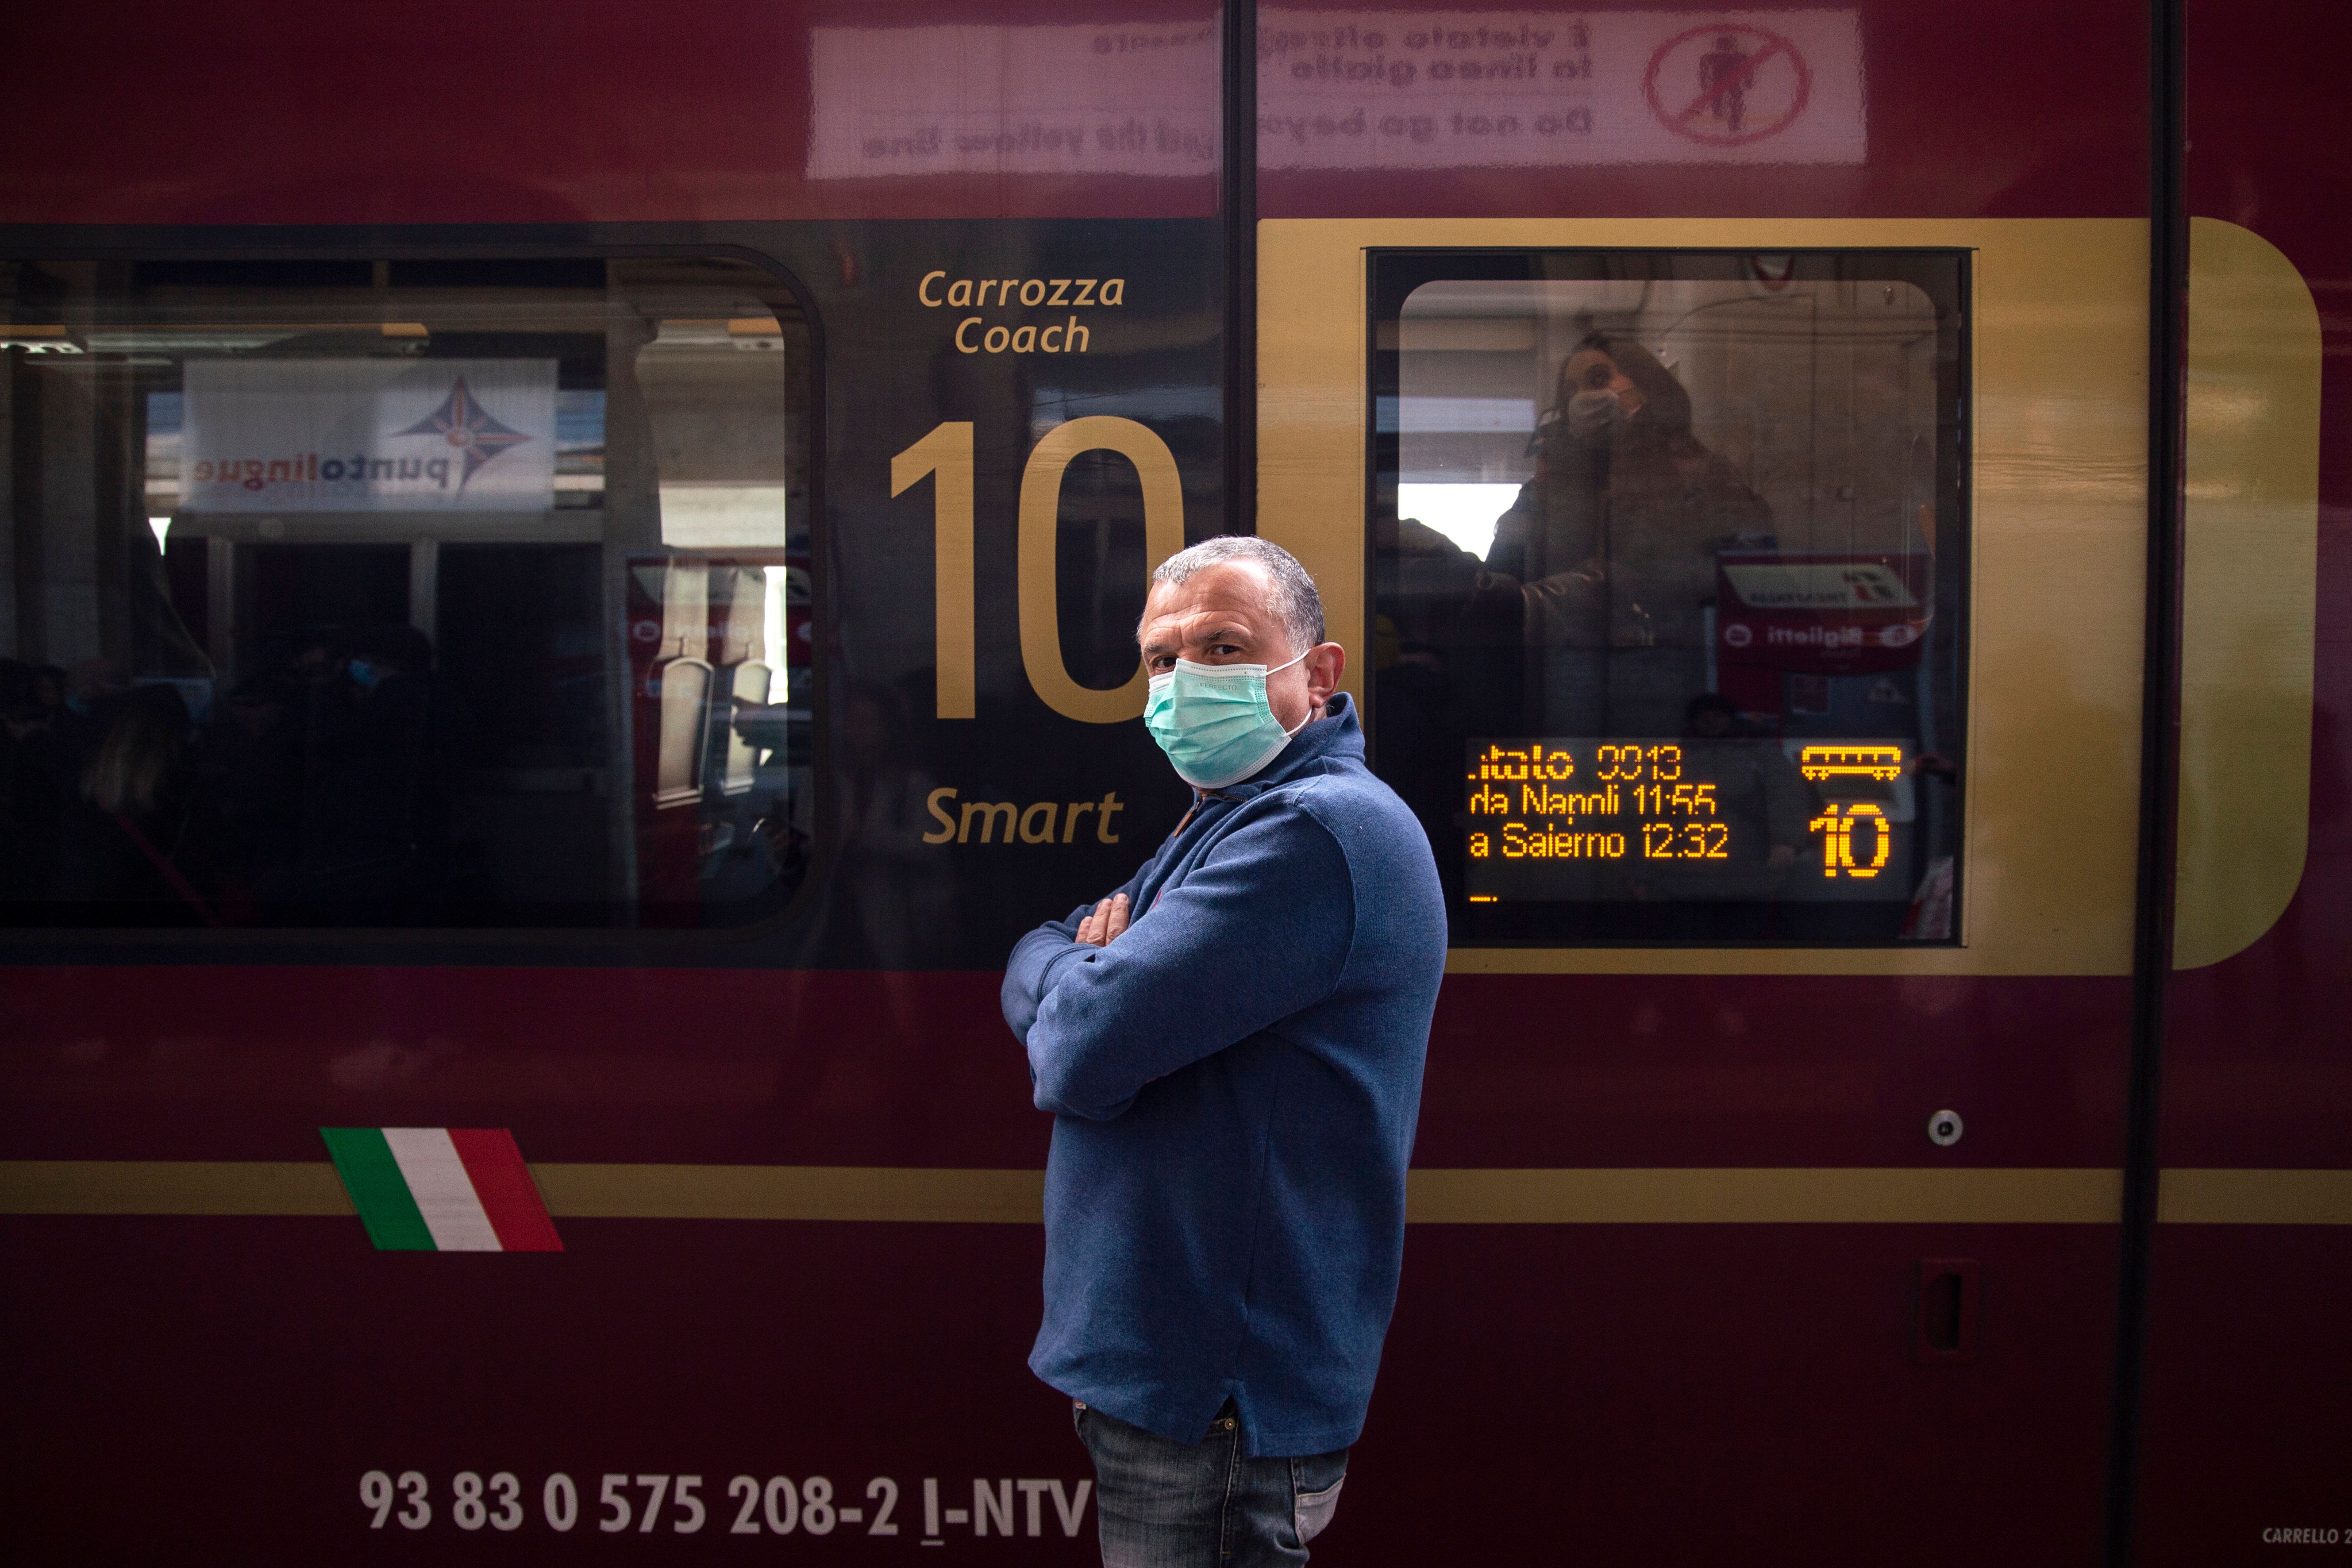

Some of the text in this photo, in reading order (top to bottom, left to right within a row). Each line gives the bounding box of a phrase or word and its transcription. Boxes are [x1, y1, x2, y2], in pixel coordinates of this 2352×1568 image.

[919, 271, 1124, 307] Carrozza
[955, 316, 1089, 354] Coach
[891, 416, 1185, 723] 10
[1200, 682, 1237, 690] PERFECTO
[924, 788, 1123, 843] Smart
[1470, 832, 1489, 858] a
[1642, 823, 1728, 859] 12:32
[1809, 803, 1890, 878] 10
[361, 1472, 1092, 1545] 93 83 0 575 208-2 I-NTV
[2262, 1527, 2339, 1544] CARRELLO
